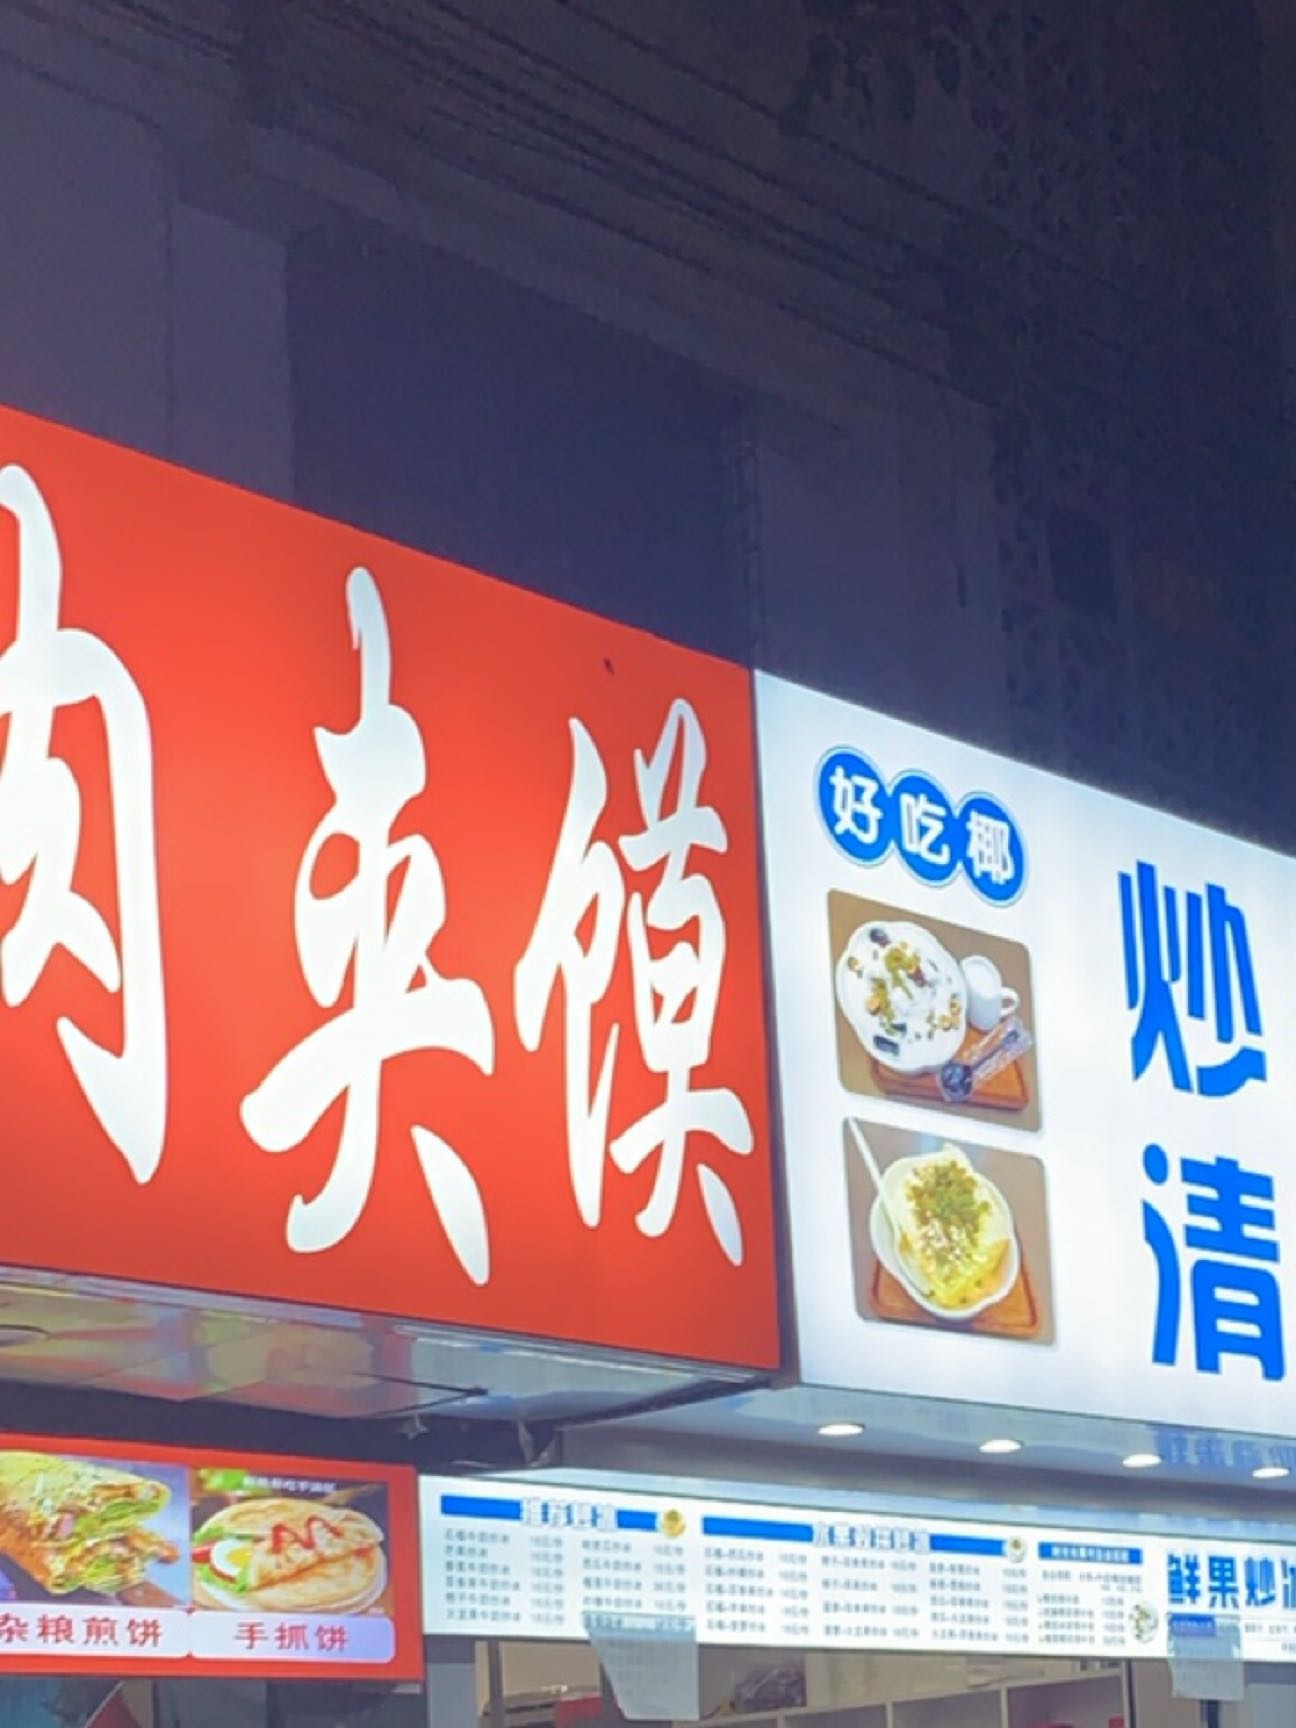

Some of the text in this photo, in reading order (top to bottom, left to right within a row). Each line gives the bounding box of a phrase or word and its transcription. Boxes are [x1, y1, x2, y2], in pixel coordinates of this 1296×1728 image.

[825, 760, 1018, 890] 好吃椰
[0, 1612, 163, 1649] 杂粮煎饼
[233, 1620, 350, 1653] 手抓饼
